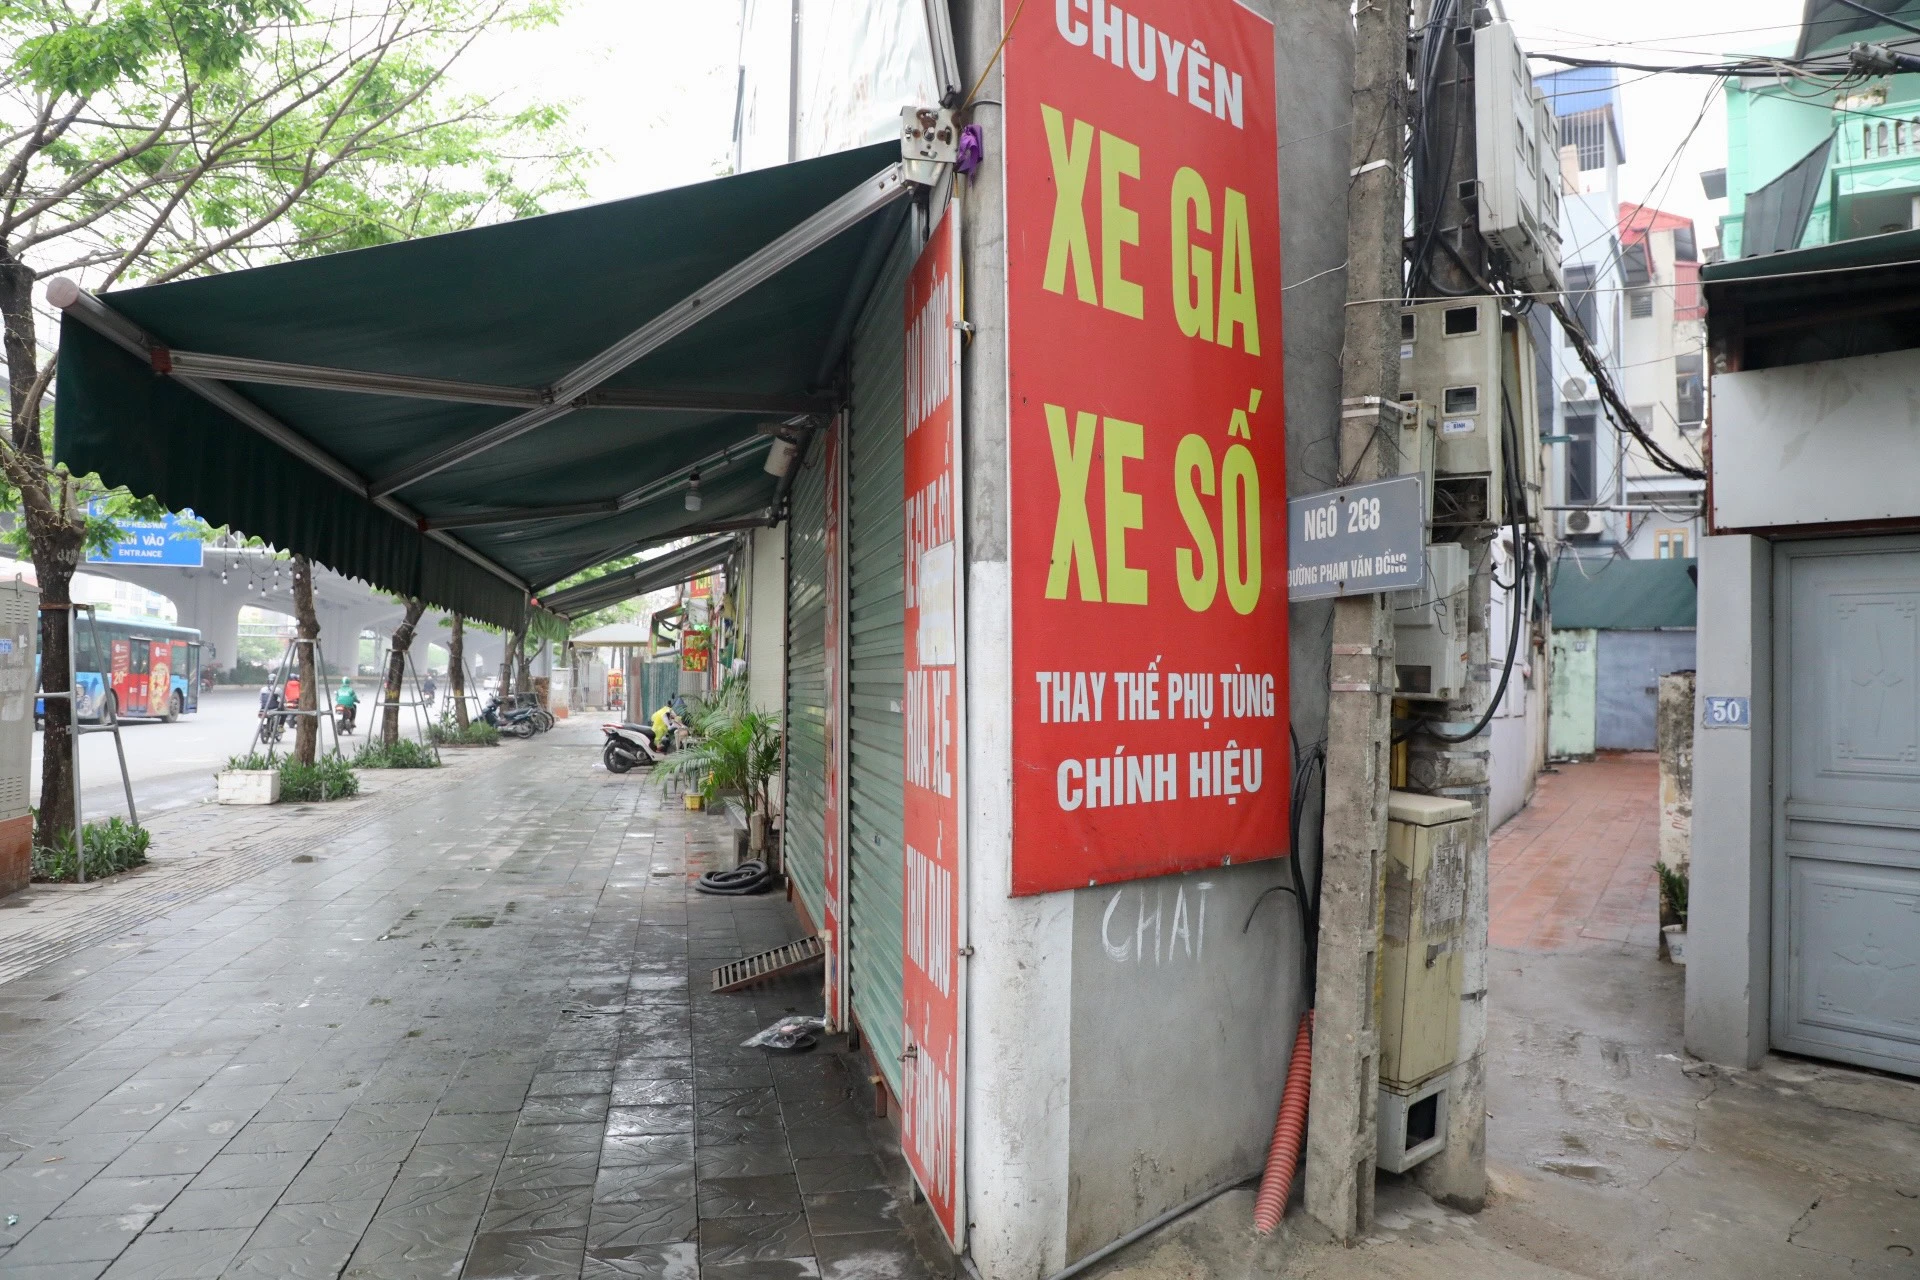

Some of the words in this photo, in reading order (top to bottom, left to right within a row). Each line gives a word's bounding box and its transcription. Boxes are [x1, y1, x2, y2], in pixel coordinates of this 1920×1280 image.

[1055, 0, 1244, 131] CHUYÊN
[1040, 102, 1144, 321] XE
[1171, 166, 1261, 357] GA
[906, 281, 920, 438] BẢO
[921, 261, 950, 422] DƯỠNG
[142, 533, 165, 547] VÀO
[1043, 402, 1148, 606] XE
[1174, 388, 1262, 616] SỐ
[1304, 499, 1338, 542] NGÕ
[119, 549, 163, 558] ENTRANCE
[1319, 557, 1348, 585] PHẠM
[1351, 555, 1373, 578] VĂN
[907, 630, 929, 789] RỬA
[933, 671, 952, 798] XE
[1036, 671, 1107, 724] THAY
[1114, 655, 1162, 721] THẾ
[1168, 672, 1214, 730] PHỤ
[1220, 664, 1275, 719] TÙNG
[1712, 700, 1741, 722] 50
[1057, 745, 1177, 812] CHÍNH
[1189, 739, 1263, 805] HIỆU
[907, 844, 927, 975] THAY
[929, 820, 951, 999] DẦU
[1101, 881, 1216, 968] CHAT
[915, 1003, 935, 1186] BIỂN
[937, 1036, 952, 1209] SỐ
